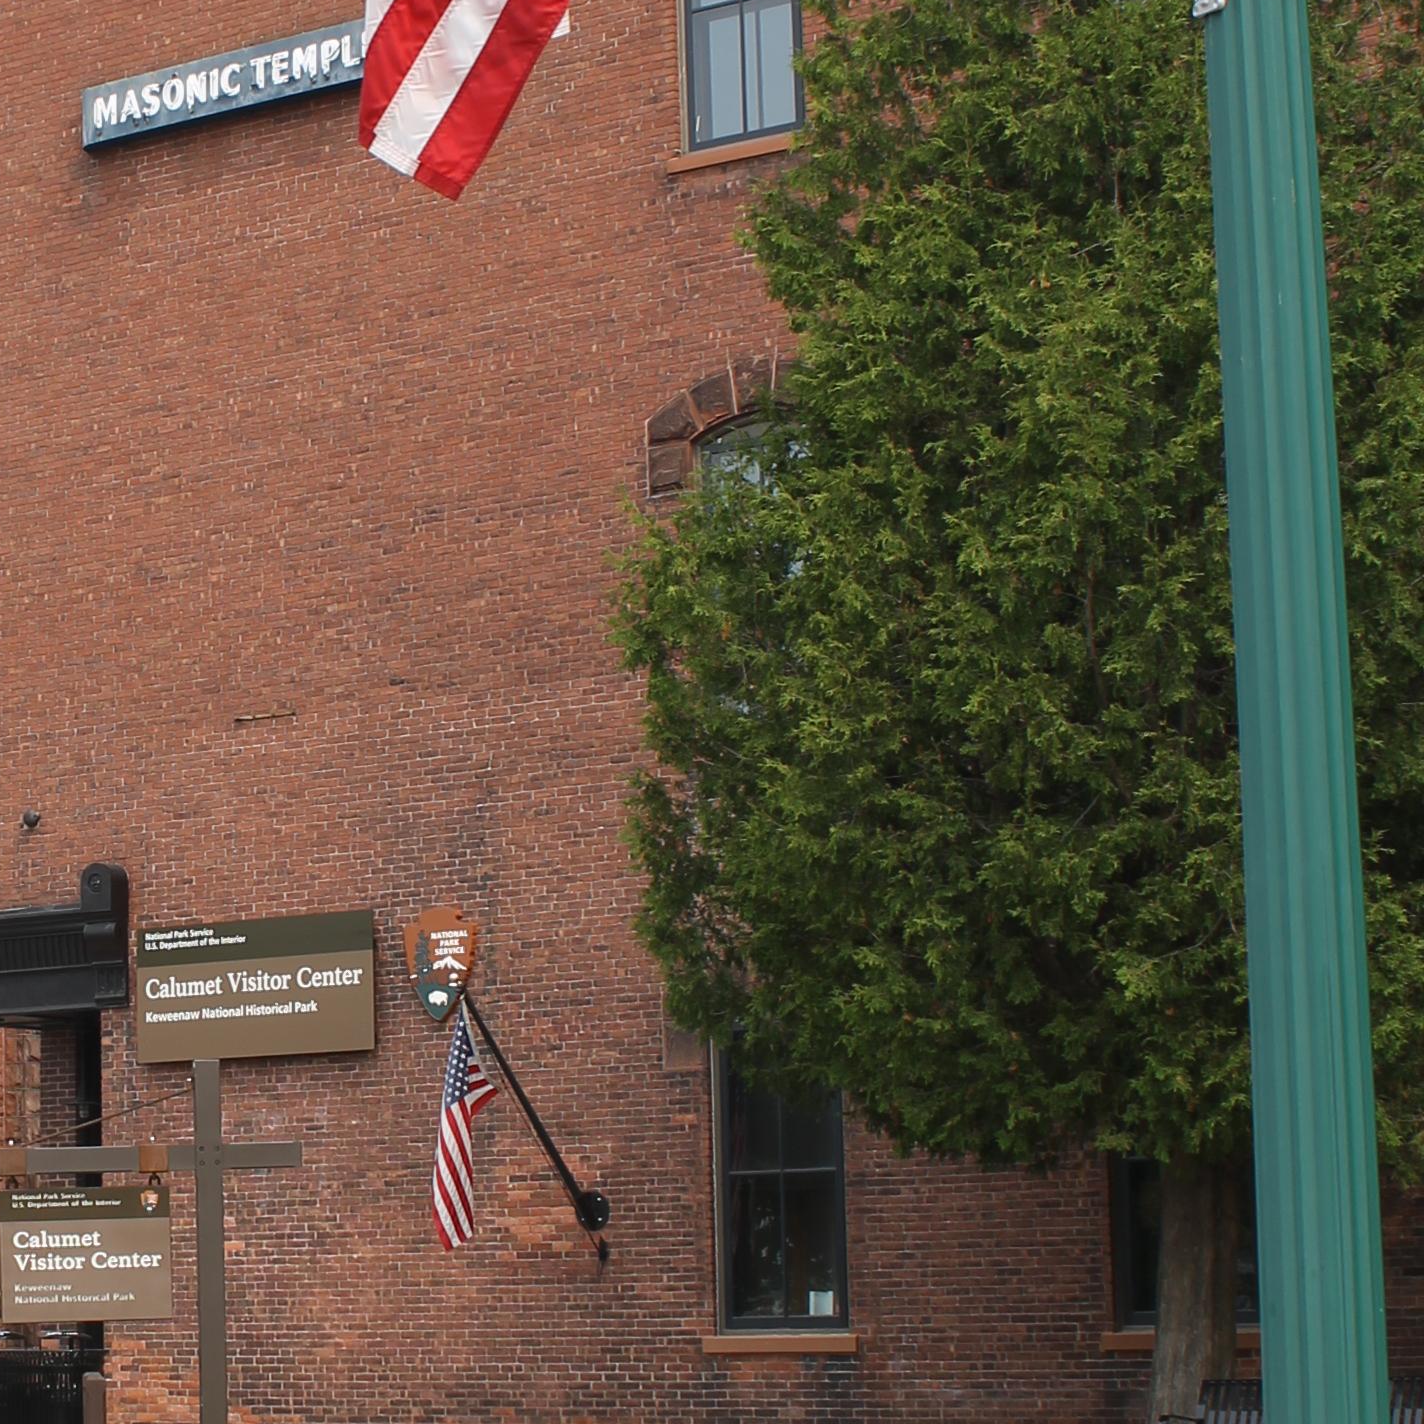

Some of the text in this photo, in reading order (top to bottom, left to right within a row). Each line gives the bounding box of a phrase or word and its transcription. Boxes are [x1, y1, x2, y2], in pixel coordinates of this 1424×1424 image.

[93, 63, 241, 129] MASONIC
[144, 928, 214, 941] National Park Service
[431, 930, 468, 939] NATIONAL
[144, 935, 246, 950] U.S. Department of the Interior
[435, 946, 464, 955] SERVICE
[145, 967, 363, 999] Calumet Visitor Center
[146, 1000, 318, 1023] Keweenaw National Historical Park
[13, 1230, 101, 1249] Calumet
[13, 1252, 162, 1271] Visitor Center
[14, 1284, 72, 1292] Keweenaw
[15, 1293, 135, 1304] National Historical Park
